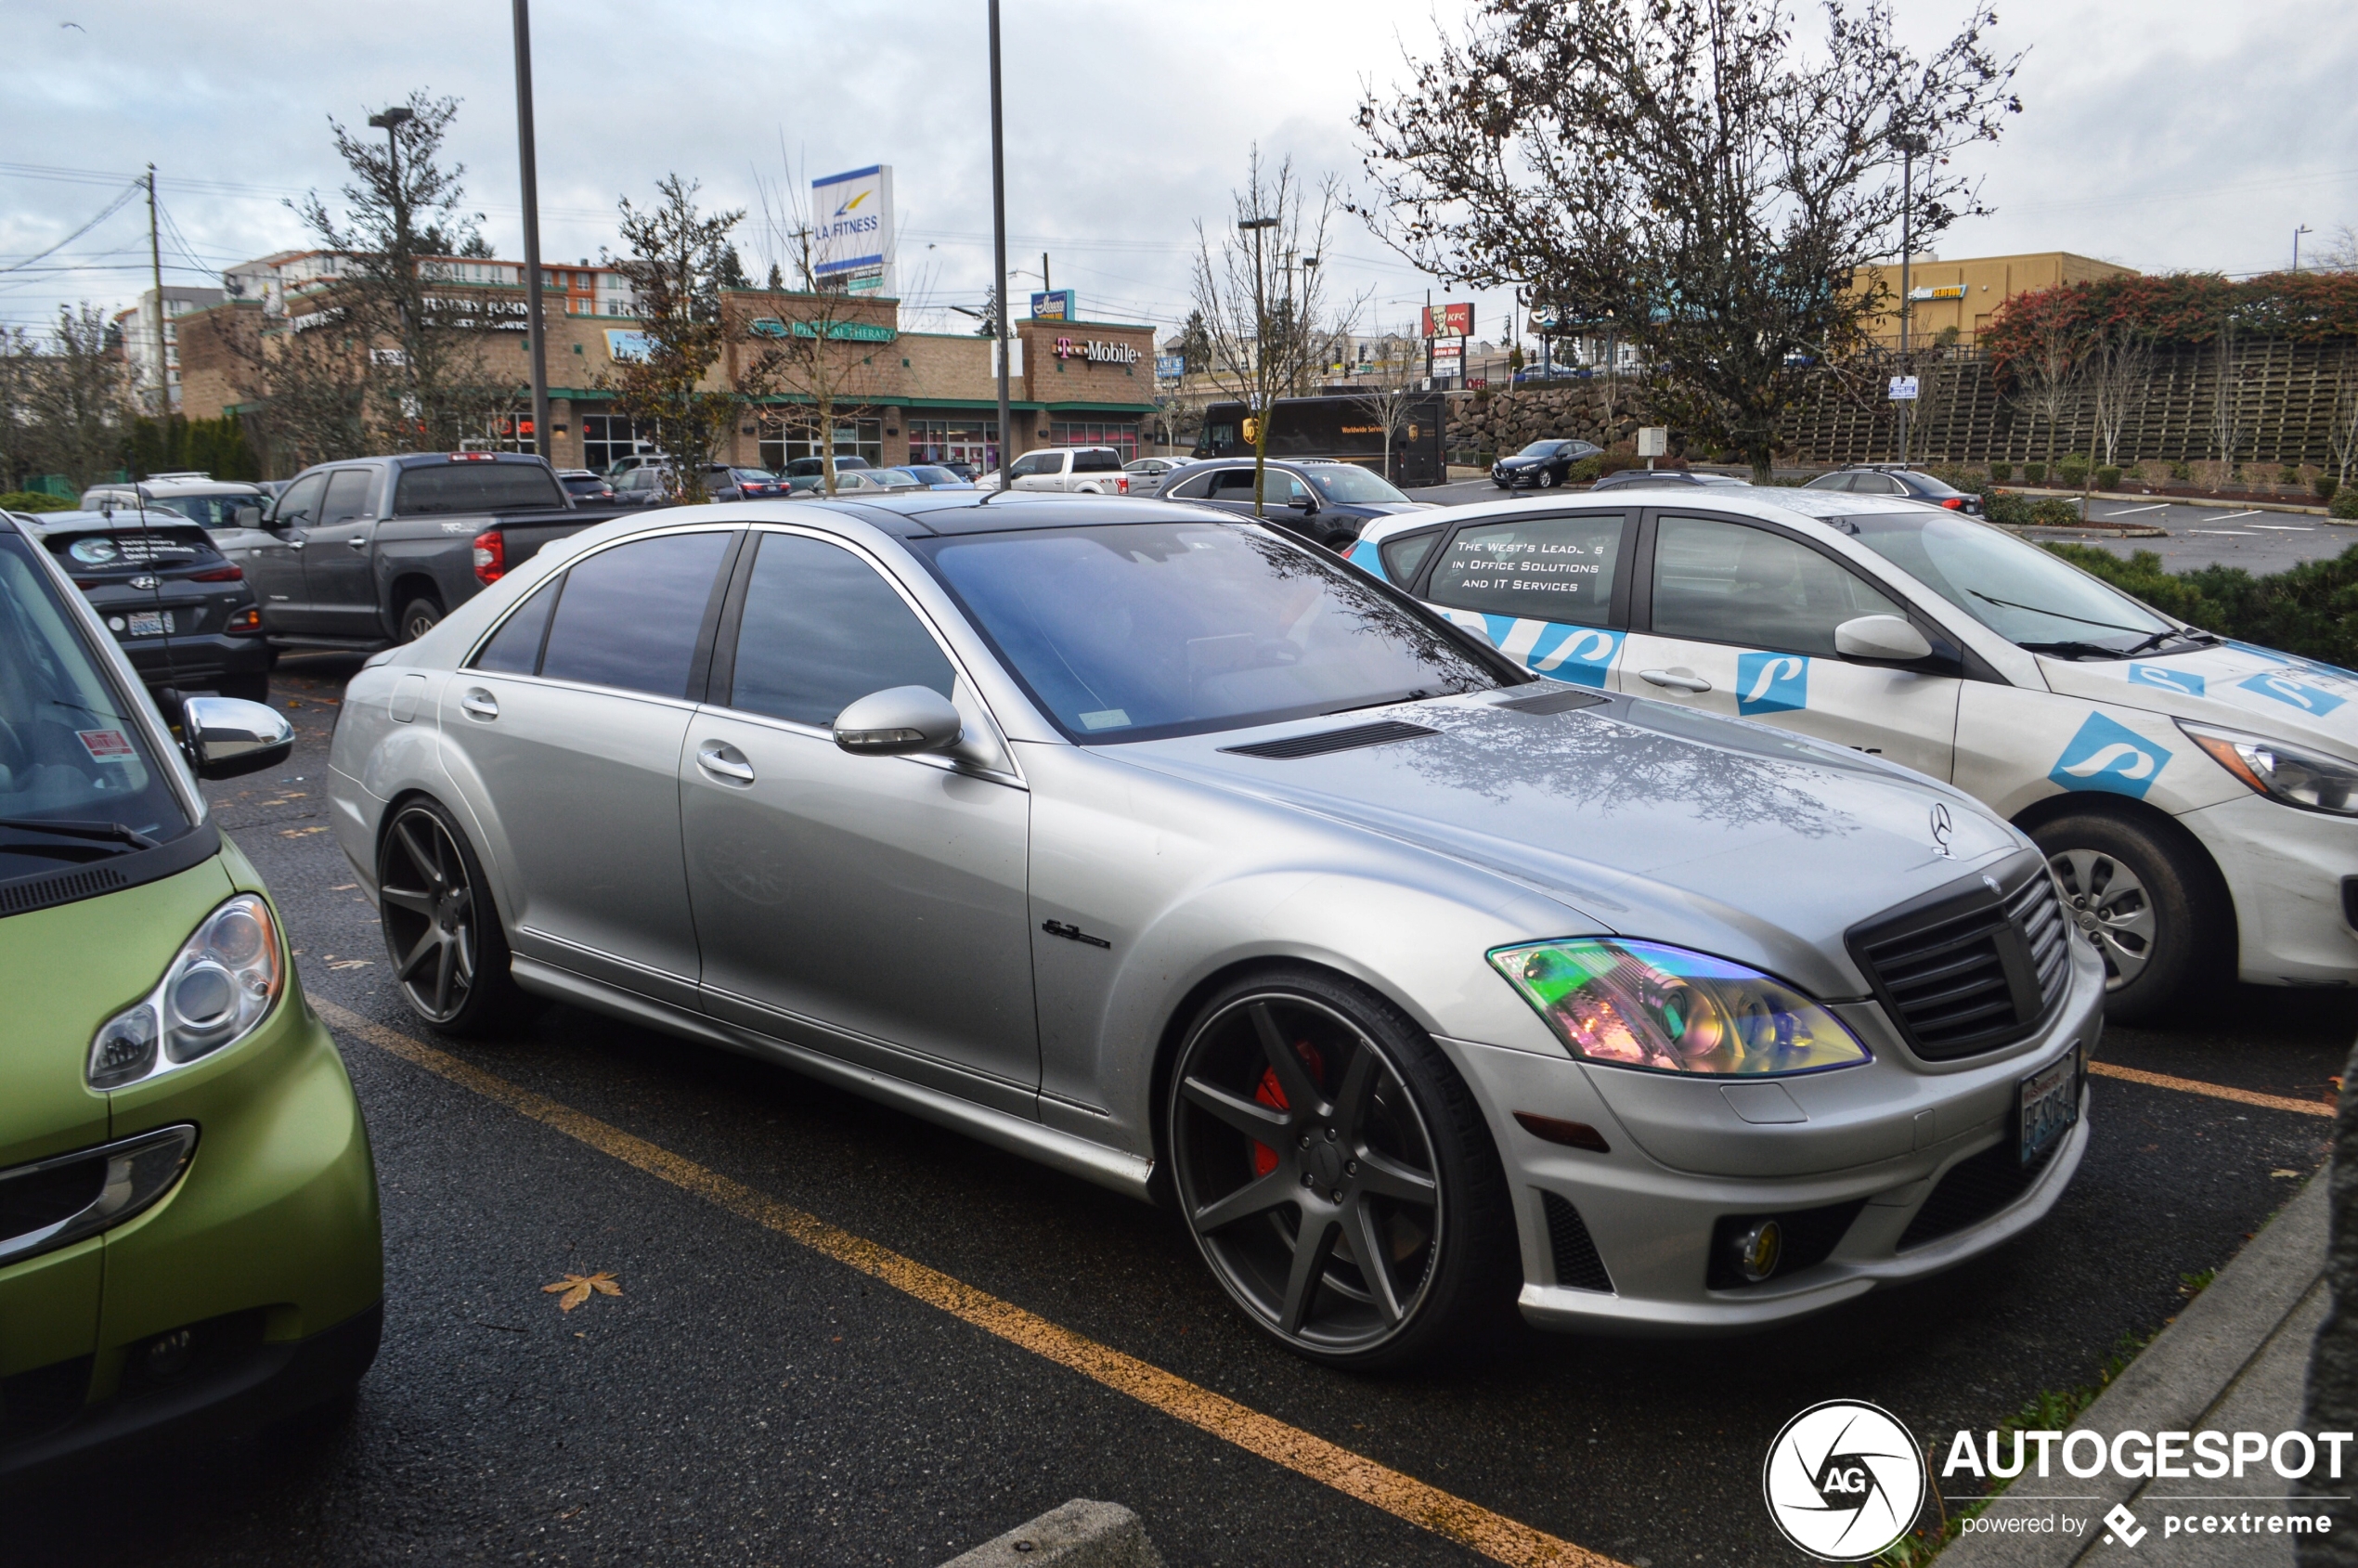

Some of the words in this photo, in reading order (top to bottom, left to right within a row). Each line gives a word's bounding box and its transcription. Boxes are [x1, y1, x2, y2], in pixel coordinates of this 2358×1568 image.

[815, 225, 829, 240] LA
[833, 214, 877, 237] FITNESS
[1447, 312, 1466, 322] KFC
[849, 328, 893, 340] THERAPY
[1458, 542, 1483, 551] THE
[1487, 542, 1536, 553] WEST'S
[1452, 561, 1465, 569] IN
[1471, 560, 1516, 571] OFFICE
[1521, 561, 1600, 574] SOLUTIONS
[1461, 579, 1489, 589] AND
[1494, 579, 1509, 589] IT
[1512, 579, 1578, 592] SERVICES
